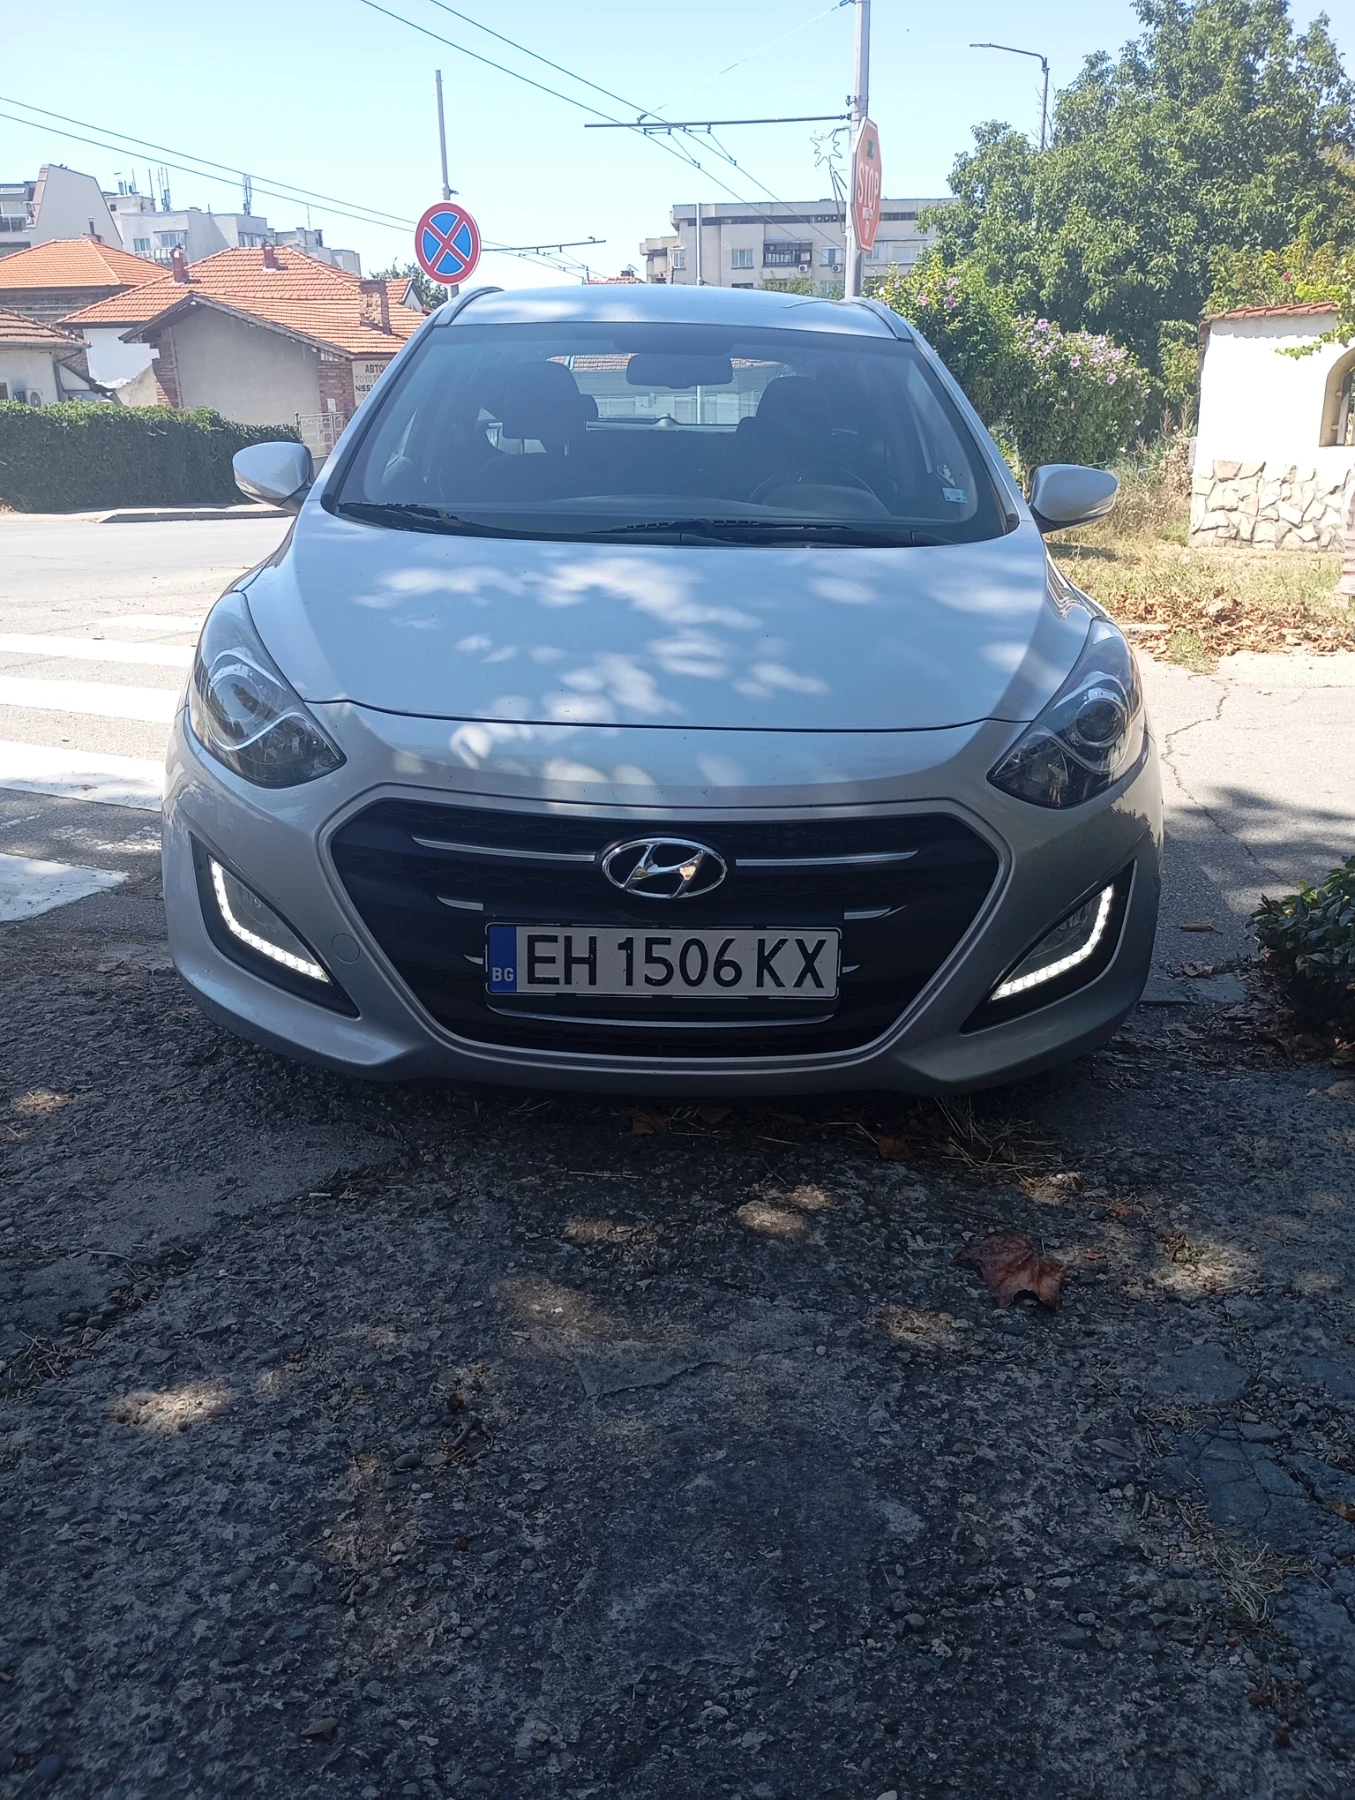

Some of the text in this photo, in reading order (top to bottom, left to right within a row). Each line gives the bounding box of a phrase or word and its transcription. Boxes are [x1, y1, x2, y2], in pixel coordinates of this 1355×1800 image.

[858, 161, 879, 210] STOP
[355, 374, 380, 384] TOYOT
[355, 384, 373, 392] NISS
[527, 934, 827, 989] EH 1506 KX
[492, 967, 514, 982] BG
